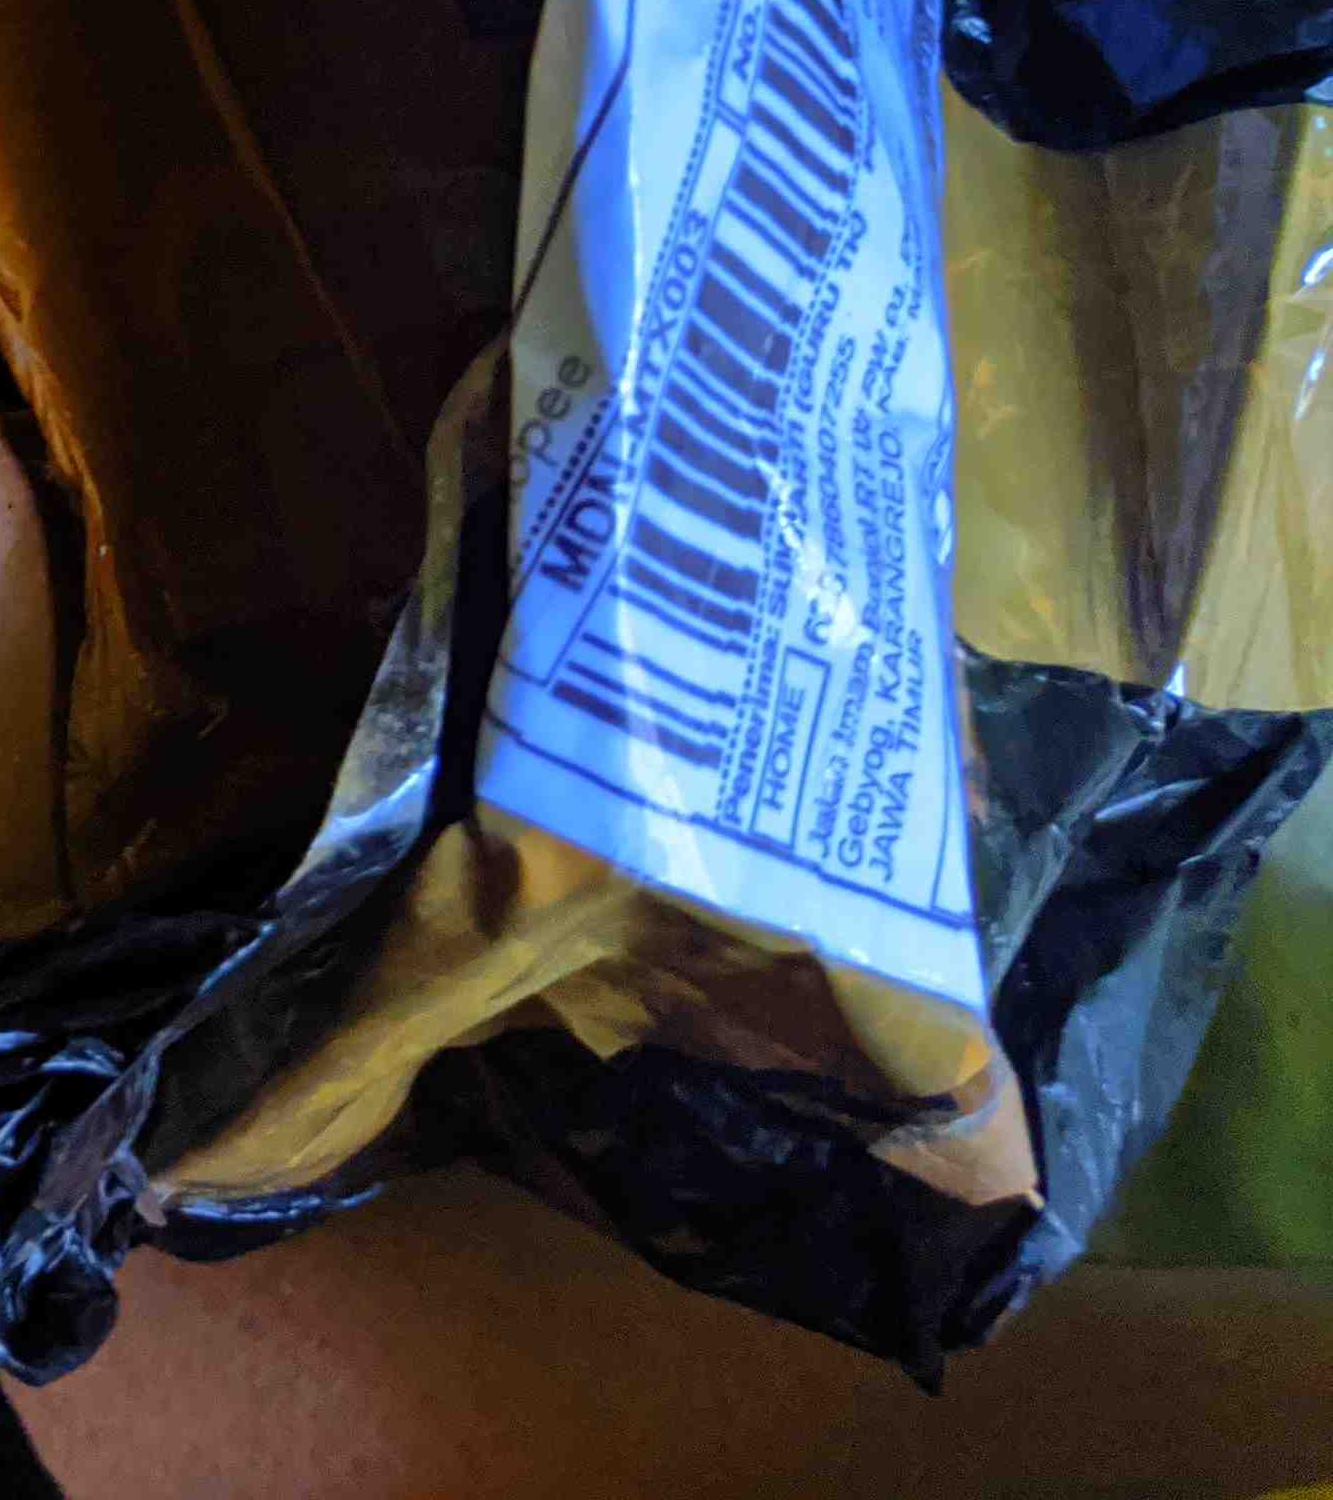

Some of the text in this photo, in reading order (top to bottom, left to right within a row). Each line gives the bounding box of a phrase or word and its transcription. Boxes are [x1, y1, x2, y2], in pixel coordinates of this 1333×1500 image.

[723, 626, 780, 826] Penerima:
[760, 683, 805, 812] HOME
[869, 628, 924, 884] JAWA TIMUR
